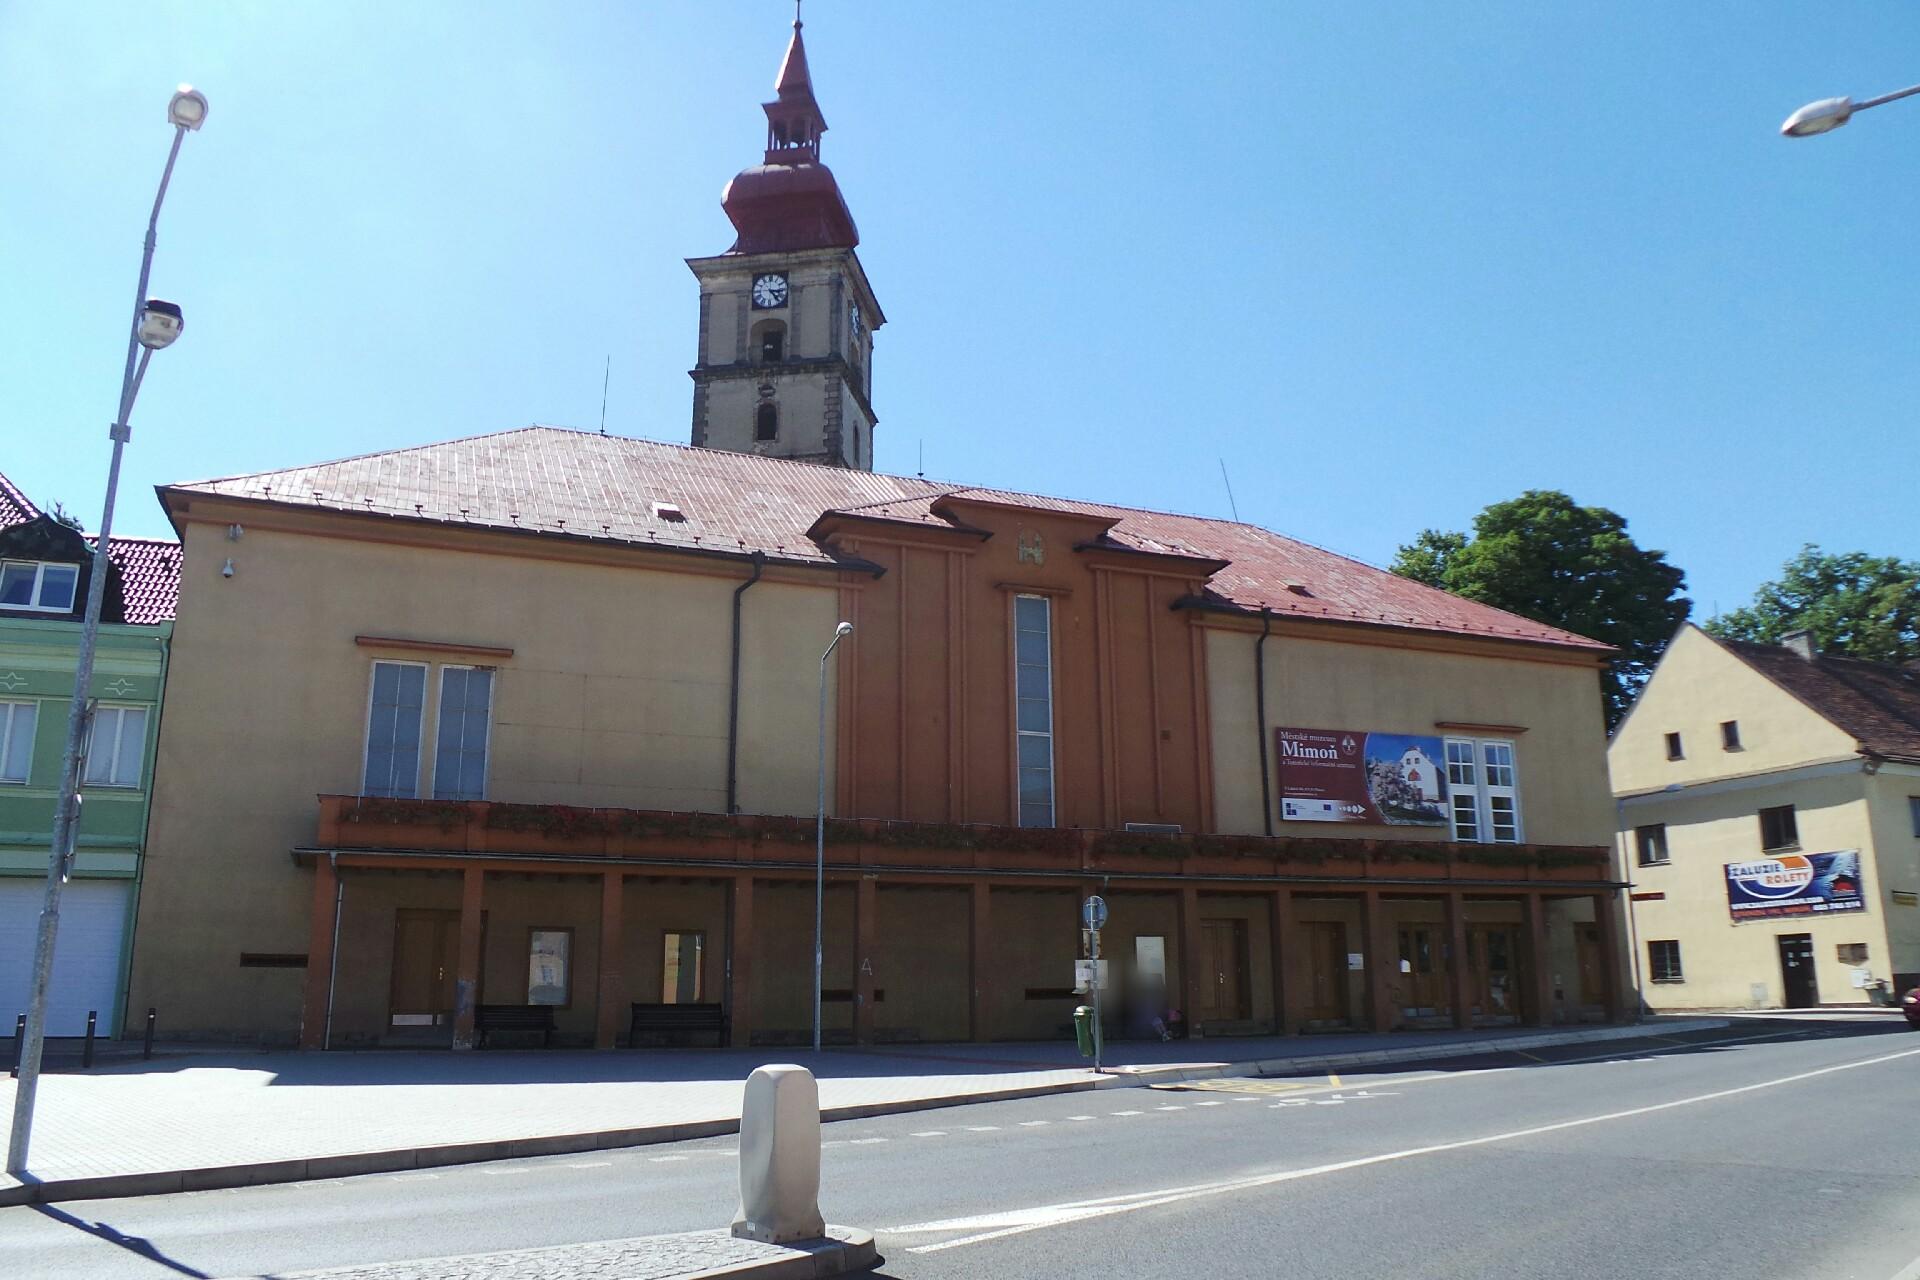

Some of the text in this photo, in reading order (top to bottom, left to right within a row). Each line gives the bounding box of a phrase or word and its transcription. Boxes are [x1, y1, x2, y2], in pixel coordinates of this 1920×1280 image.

[1309, 735, 1337, 743] muzeum
[1281, 740, 1339, 760] Mimoň
[1766, 872, 1809, 885] ROLETY
